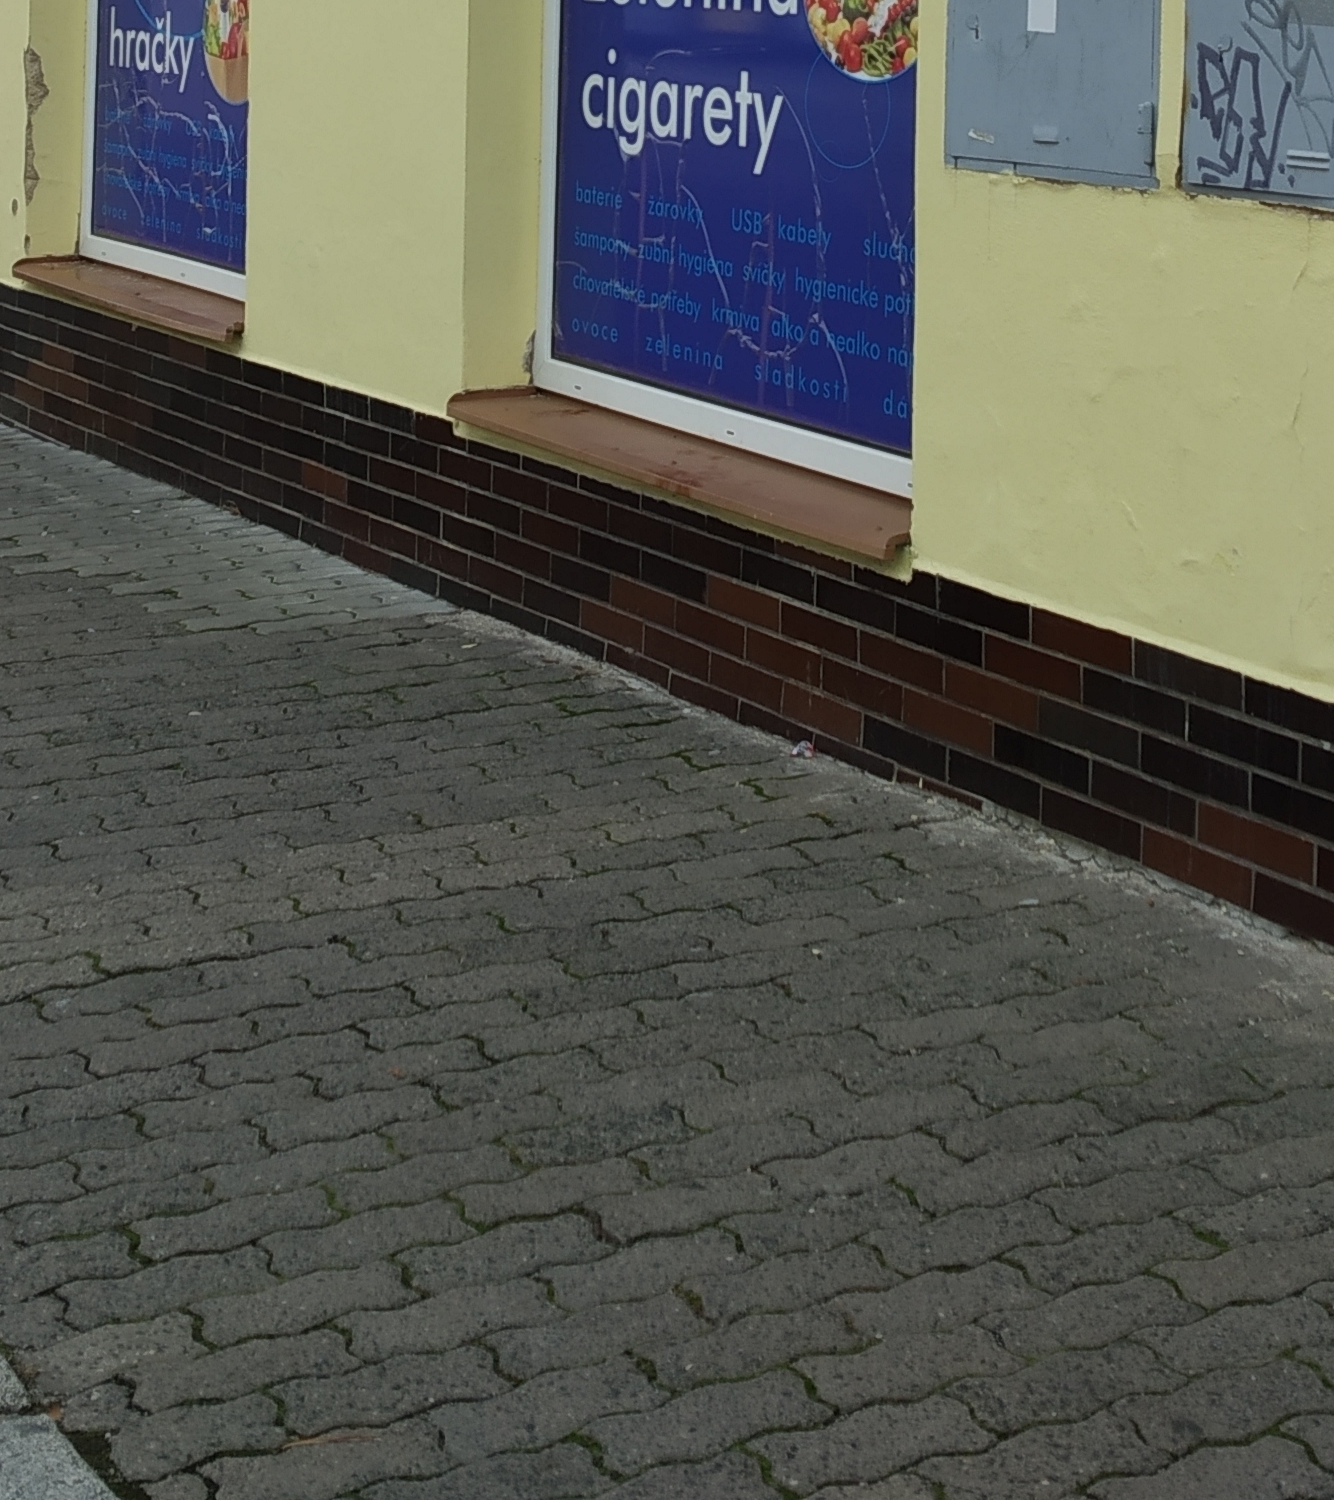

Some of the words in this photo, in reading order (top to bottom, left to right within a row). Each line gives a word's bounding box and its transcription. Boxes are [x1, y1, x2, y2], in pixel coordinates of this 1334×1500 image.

[108, 4, 193, 94] hračky
[580, 48, 784, 175] cigarety
[575, 180, 623, 209] baterie
[647, 193, 703, 228] žárovky
[731, 207, 763, 236] USB
[777, 214, 831, 249] kabely
[573, 228, 631, 258] šampony
[678, 244, 733, 279] hygiena
[742, 260, 785, 295] svíčky
[794, 267, 879, 309] hygienické
[884, 293, 915, 318] pot
[571, 317, 619, 344] ovoce
[644, 334, 724, 371] zelenina
[754, 360, 847, 403] sladkosti
[650, 285, 701, 319] potřeby
[710, 305, 760, 333] krmiva
[771, 315, 804, 343] alko
[810, 330, 819, 346] a
[826, 329, 880, 360] nealko
